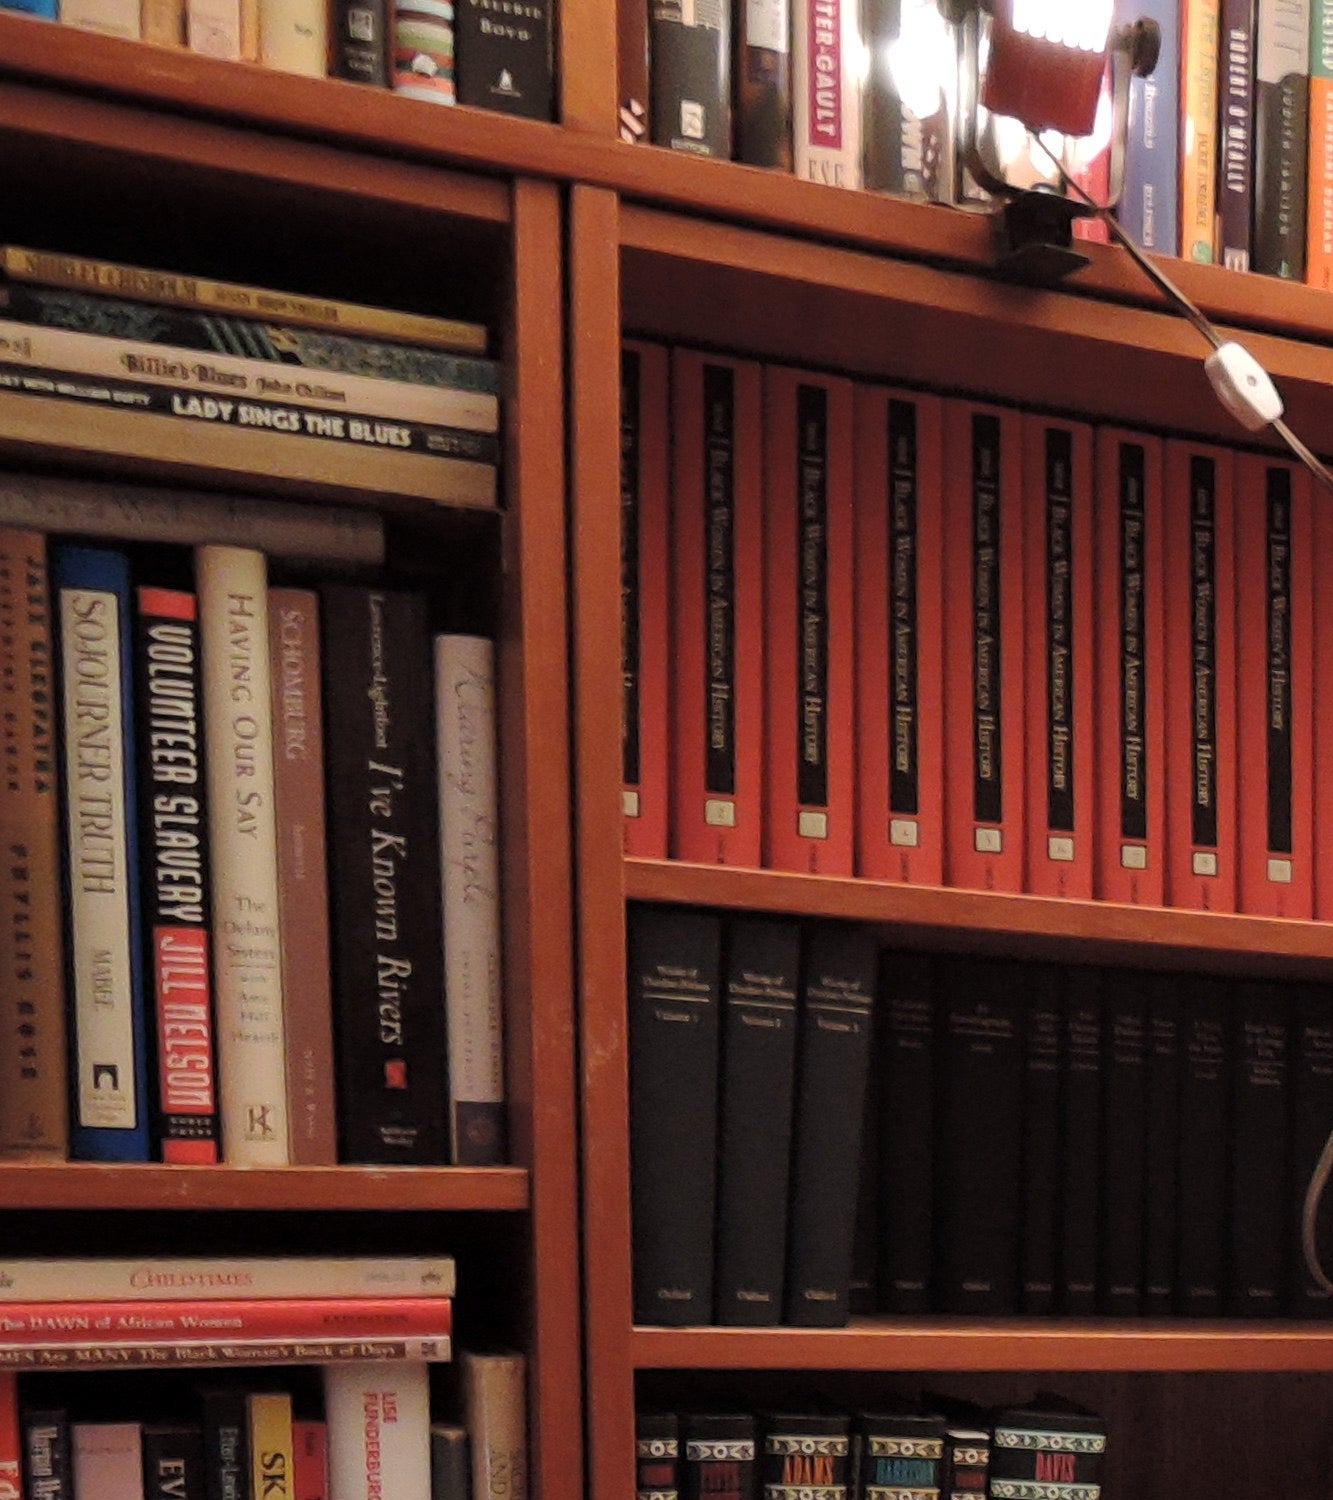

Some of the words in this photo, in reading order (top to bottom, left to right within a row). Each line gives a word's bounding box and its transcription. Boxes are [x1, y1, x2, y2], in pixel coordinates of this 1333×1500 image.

[171, 395, 234, 422] LADY
[237, 404, 301, 432] SINGS
[305, 414, 345, 438] THE
[350, 420, 411, 449] BLUES
[71, 596, 115, 780] SOJOURNER
[228, 594, 254, 702] HAVING
[146, 624, 199, 784] VOLUNTEER
[234, 716, 259, 777] OUR
[235, 789, 262, 840] SAY
[366, 760, 403, 817] I've
[79, 792, 117, 895] TRUTH
[153, 794, 204, 924] SLAVERY
[369, 827, 402, 941] Known
[160, 934, 204, 994] JILL
[376, 954, 414, 1045] Rivers
[164, 1003, 212, 1107] NELSON
